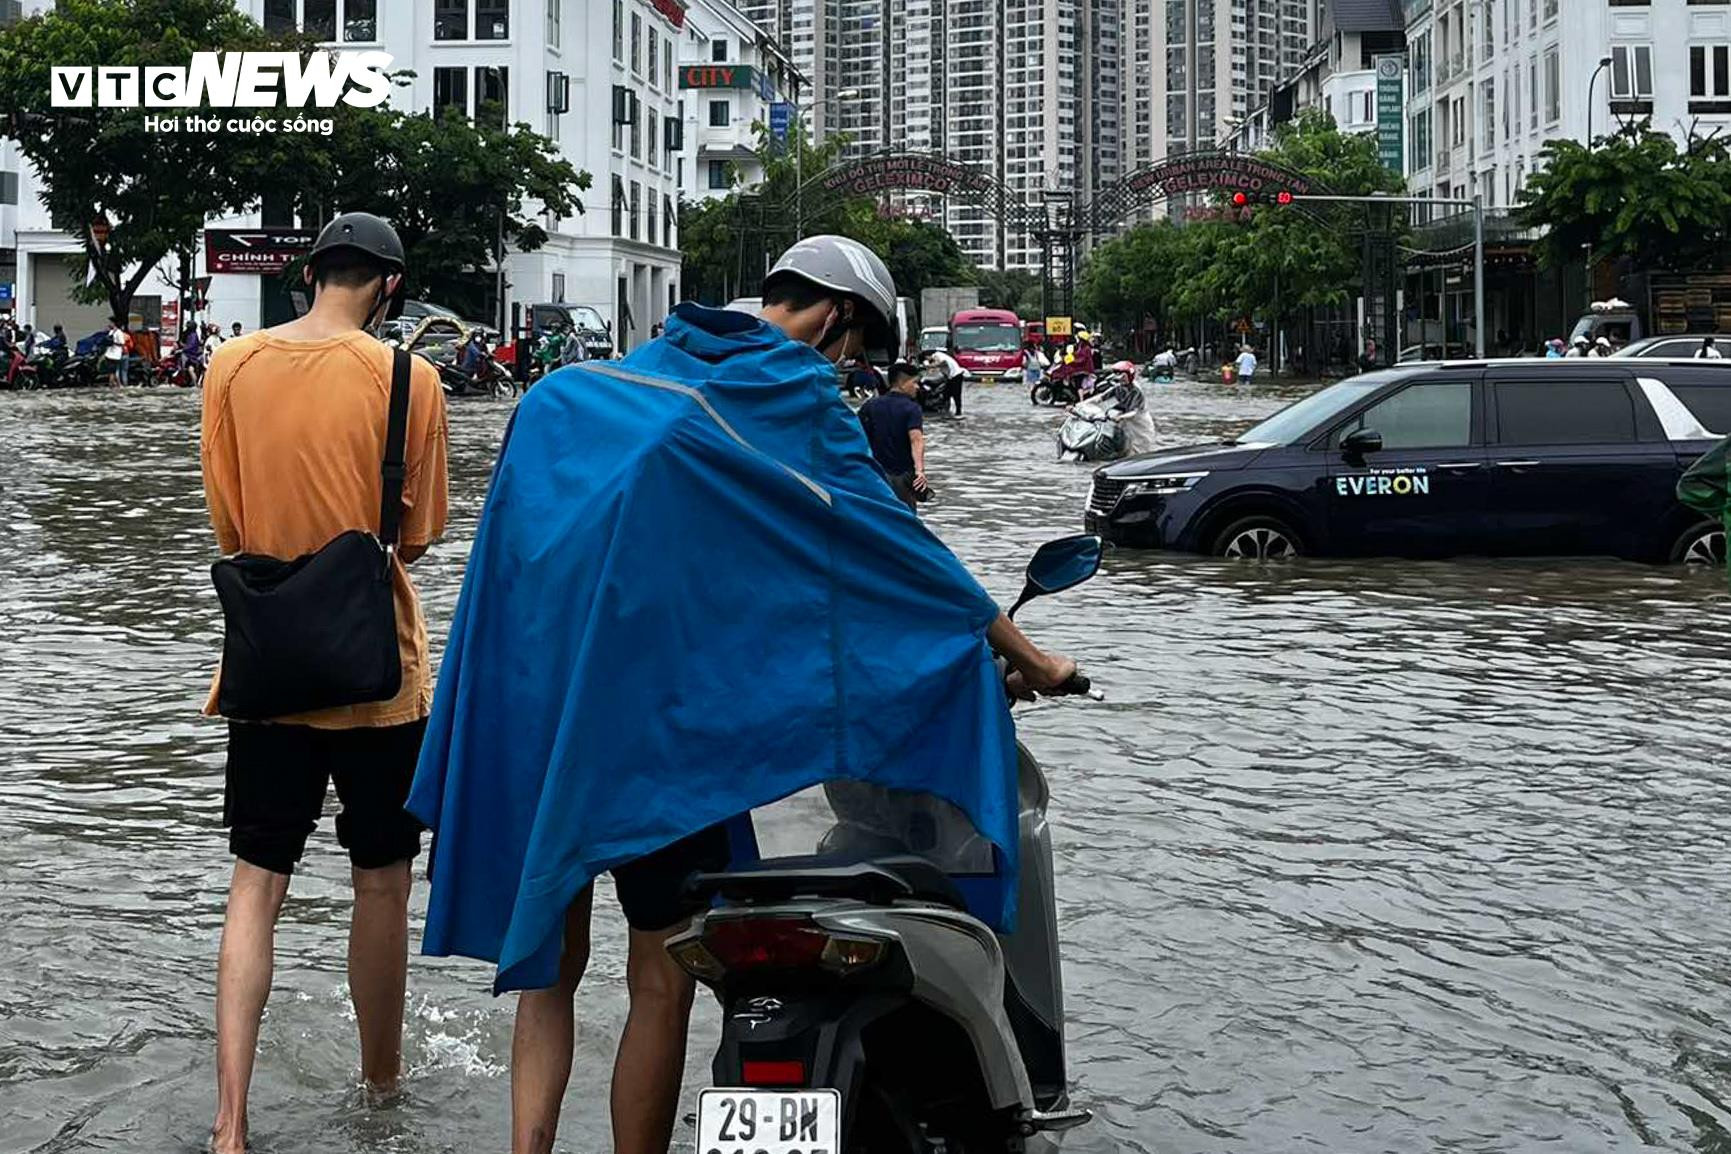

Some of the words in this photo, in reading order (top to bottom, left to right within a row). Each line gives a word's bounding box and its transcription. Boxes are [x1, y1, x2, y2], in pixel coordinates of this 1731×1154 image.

[854, 171, 948, 193] GELEXIMCO
[1165, 172, 1262, 194] GELEXIMCO
[218, 252, 275, 262] CHÍNH
[1336, 475, 1429, 496] EVERON
[718, 1097, 818, 1142] 29-BN
